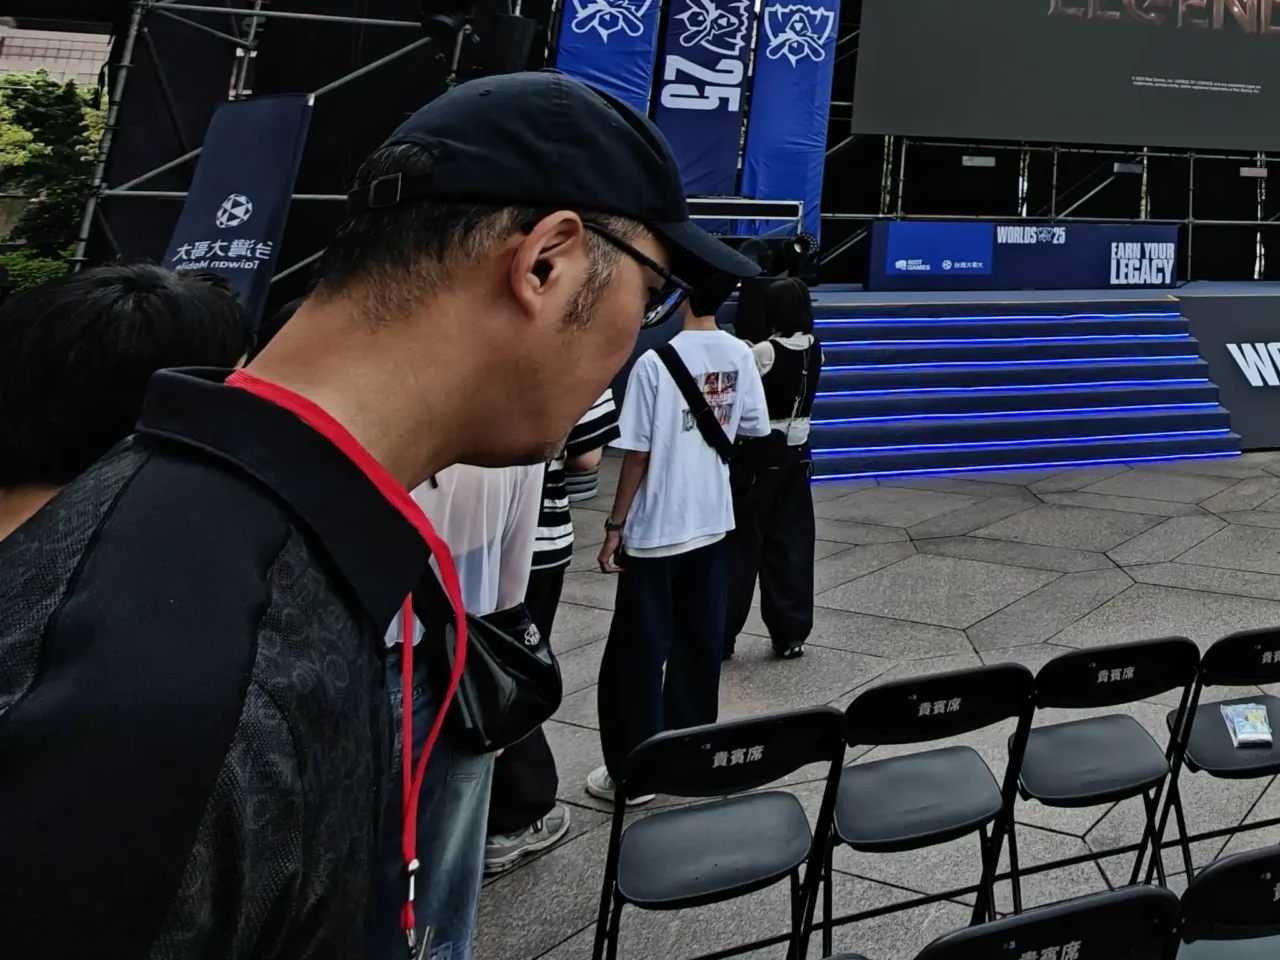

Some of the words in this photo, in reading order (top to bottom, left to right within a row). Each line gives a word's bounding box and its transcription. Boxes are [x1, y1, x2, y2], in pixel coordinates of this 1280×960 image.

[660, 55, 744, 112] 25
[997, 226, 1037, 244] WORLDS
[1052, 227, 1066, 244] 25
[1111, 242, 1142, 259] EARN
[1144, 242, 1175, 259] YOUR
[1110, 259, 1173, 285] LEGACY
[918, 697, 962, 717] 貴賓席
[712, 745, 764, 768] 貴賓席
